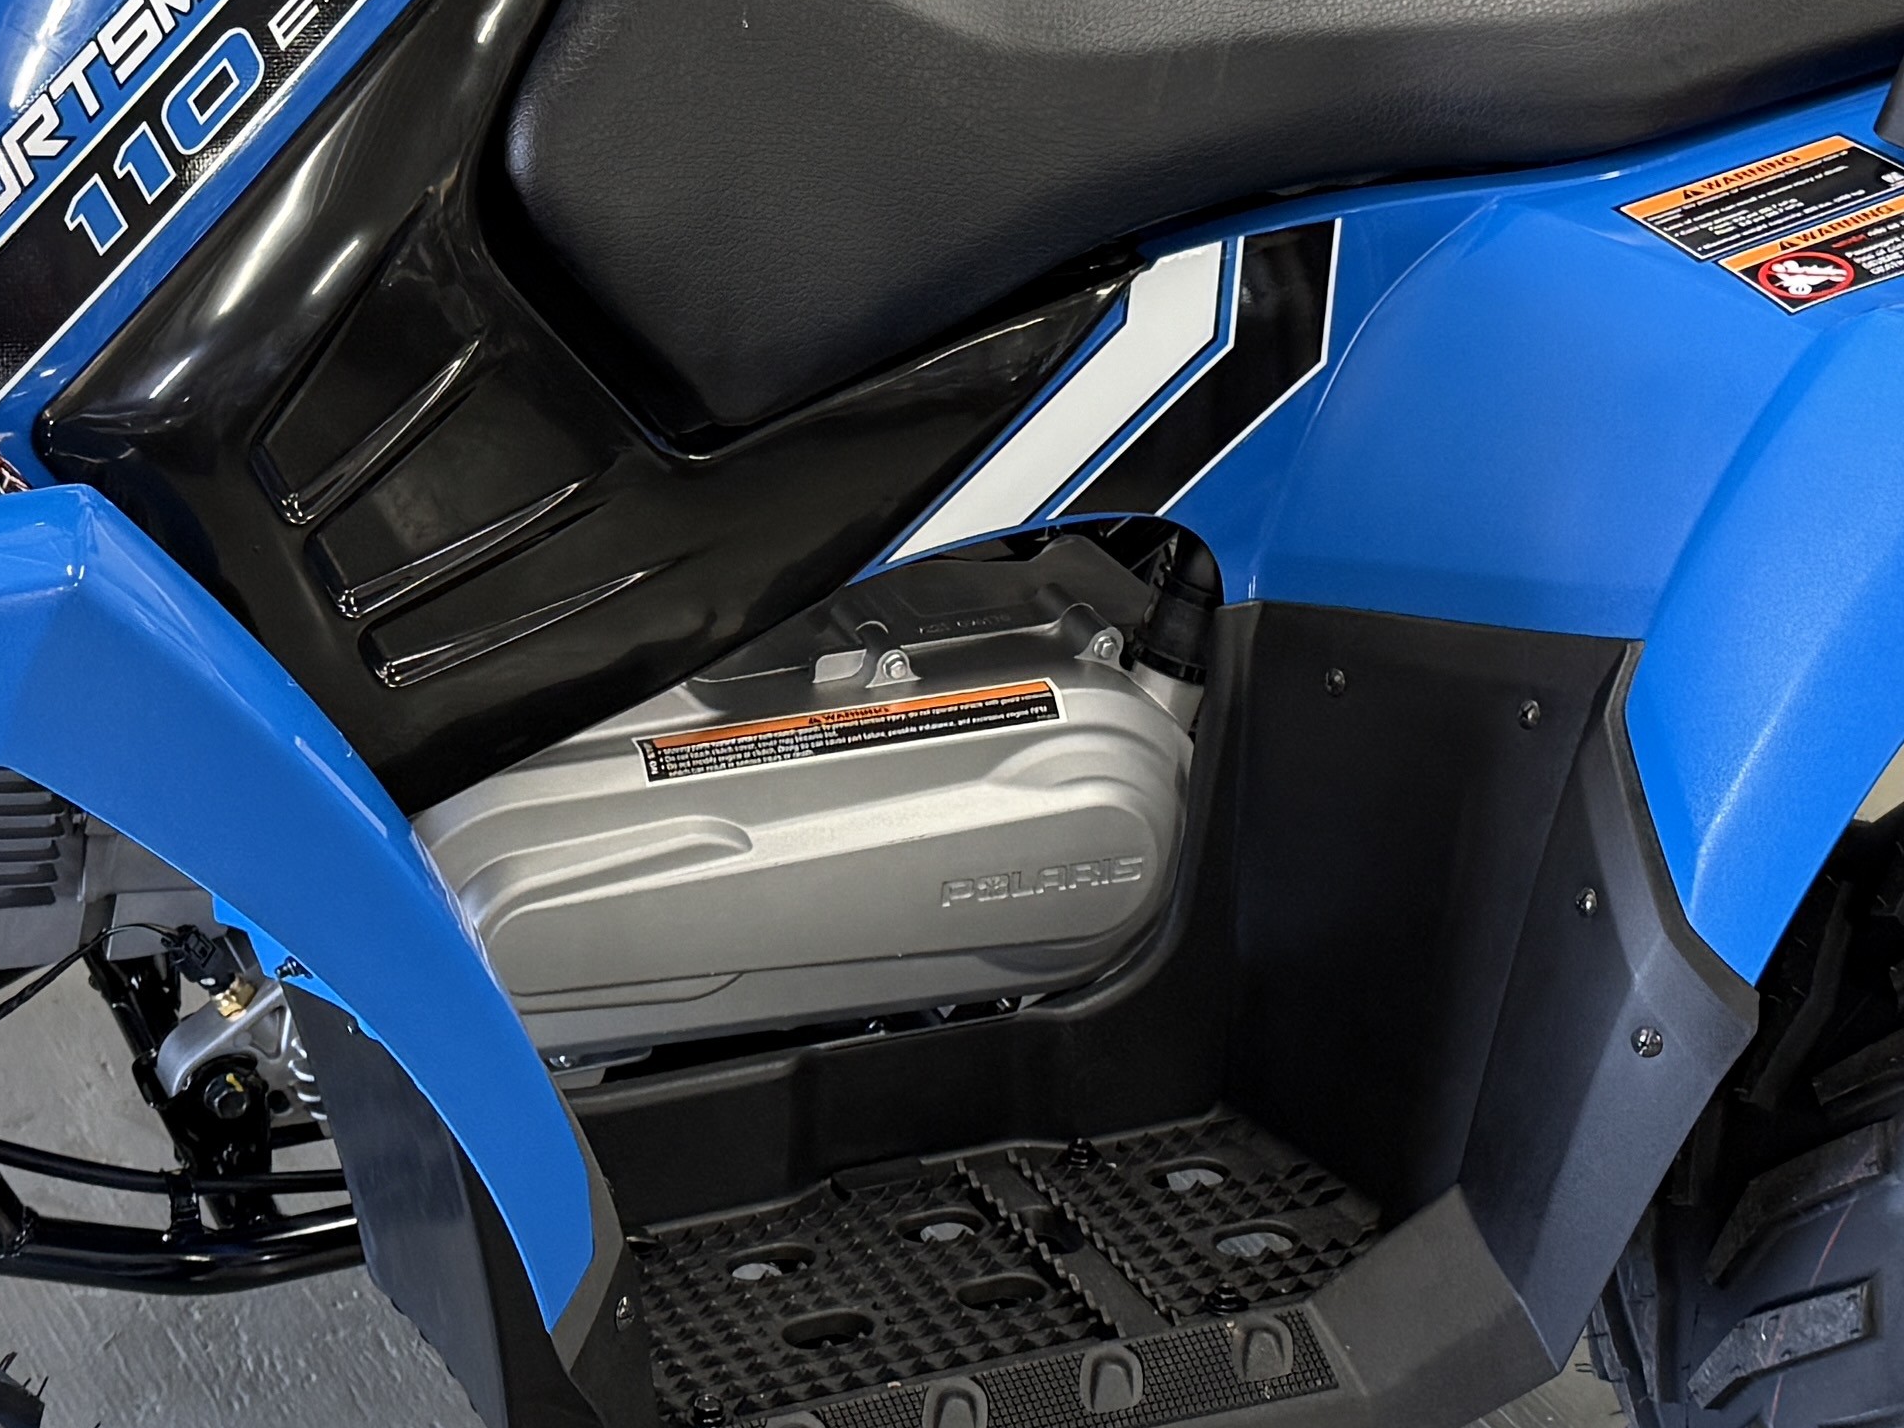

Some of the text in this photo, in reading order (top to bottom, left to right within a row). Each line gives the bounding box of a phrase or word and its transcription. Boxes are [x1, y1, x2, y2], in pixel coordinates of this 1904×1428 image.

[65, 27, 265, 256] 110
[1702, 154, 1802, 190] WARNING
[1794, 203, 1895, 242] WARNING
[939, 855, 1144, 908] POLARIS
